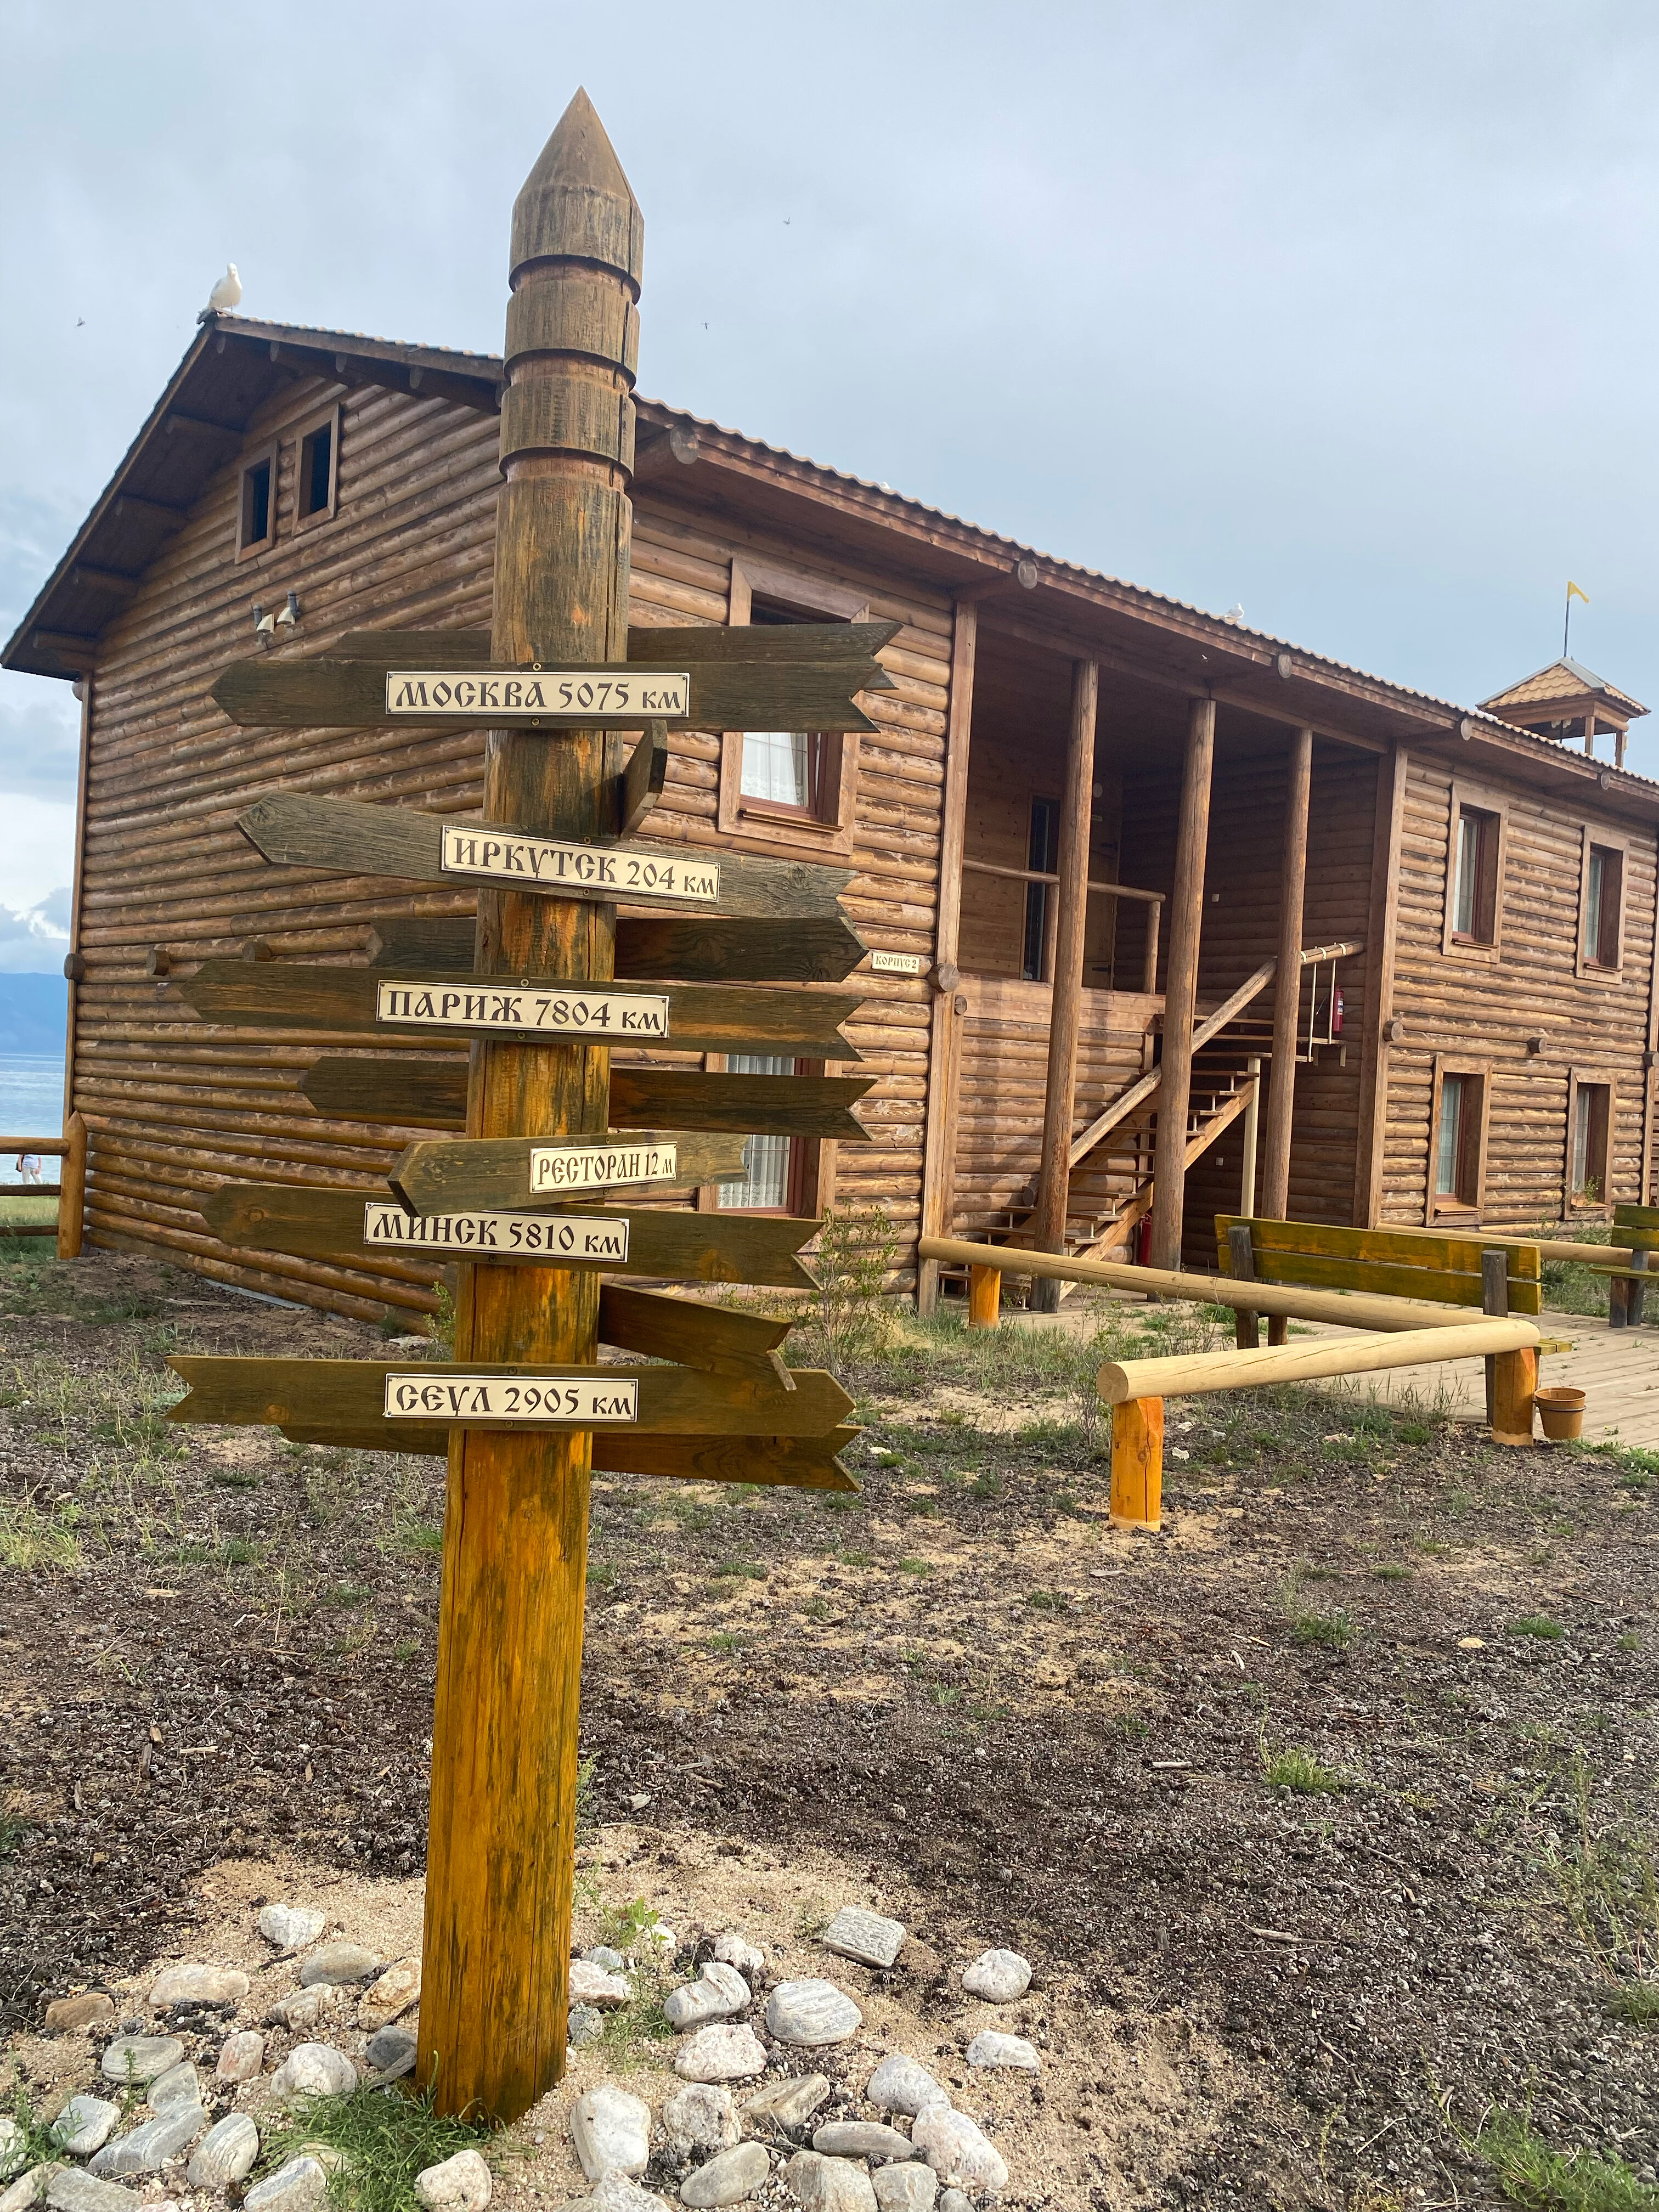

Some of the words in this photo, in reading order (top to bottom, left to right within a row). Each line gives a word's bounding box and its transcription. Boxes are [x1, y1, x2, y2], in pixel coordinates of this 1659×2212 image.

[396, 681, 547, 707] МОСКВА
[558, 682, 629, 710] 5075
[642, 691, 681, 709] км
[453, 837, 616, 883] ИРКУТСК
[627, 860, 675, 890] 204
[684, 875, 715, 895] км
[876, 955, 910, 970] КОРПУС
[912, 959, 917, 969] 2
[387, 990, 522, 1023] ПАРИЖ
[535, 998, 611, 1027] 7804
[622, 1011, 660, 1030] км
[538, 1153, 640, 1185] РЕСТОРАН
[645, 1152, 658, 1175] 12
[662, 1158, 673, 1174] м
[373, 1213, 498, 1246] МИНСК
[509, 1222, 574, 1251] 5810
[585, 1234, 621, 1254] км
[396, 1385, 493, 1417] СЕУЛ
[504, 1387, 580, 1414] 2905
[592, 1396, 631, 1415] км
